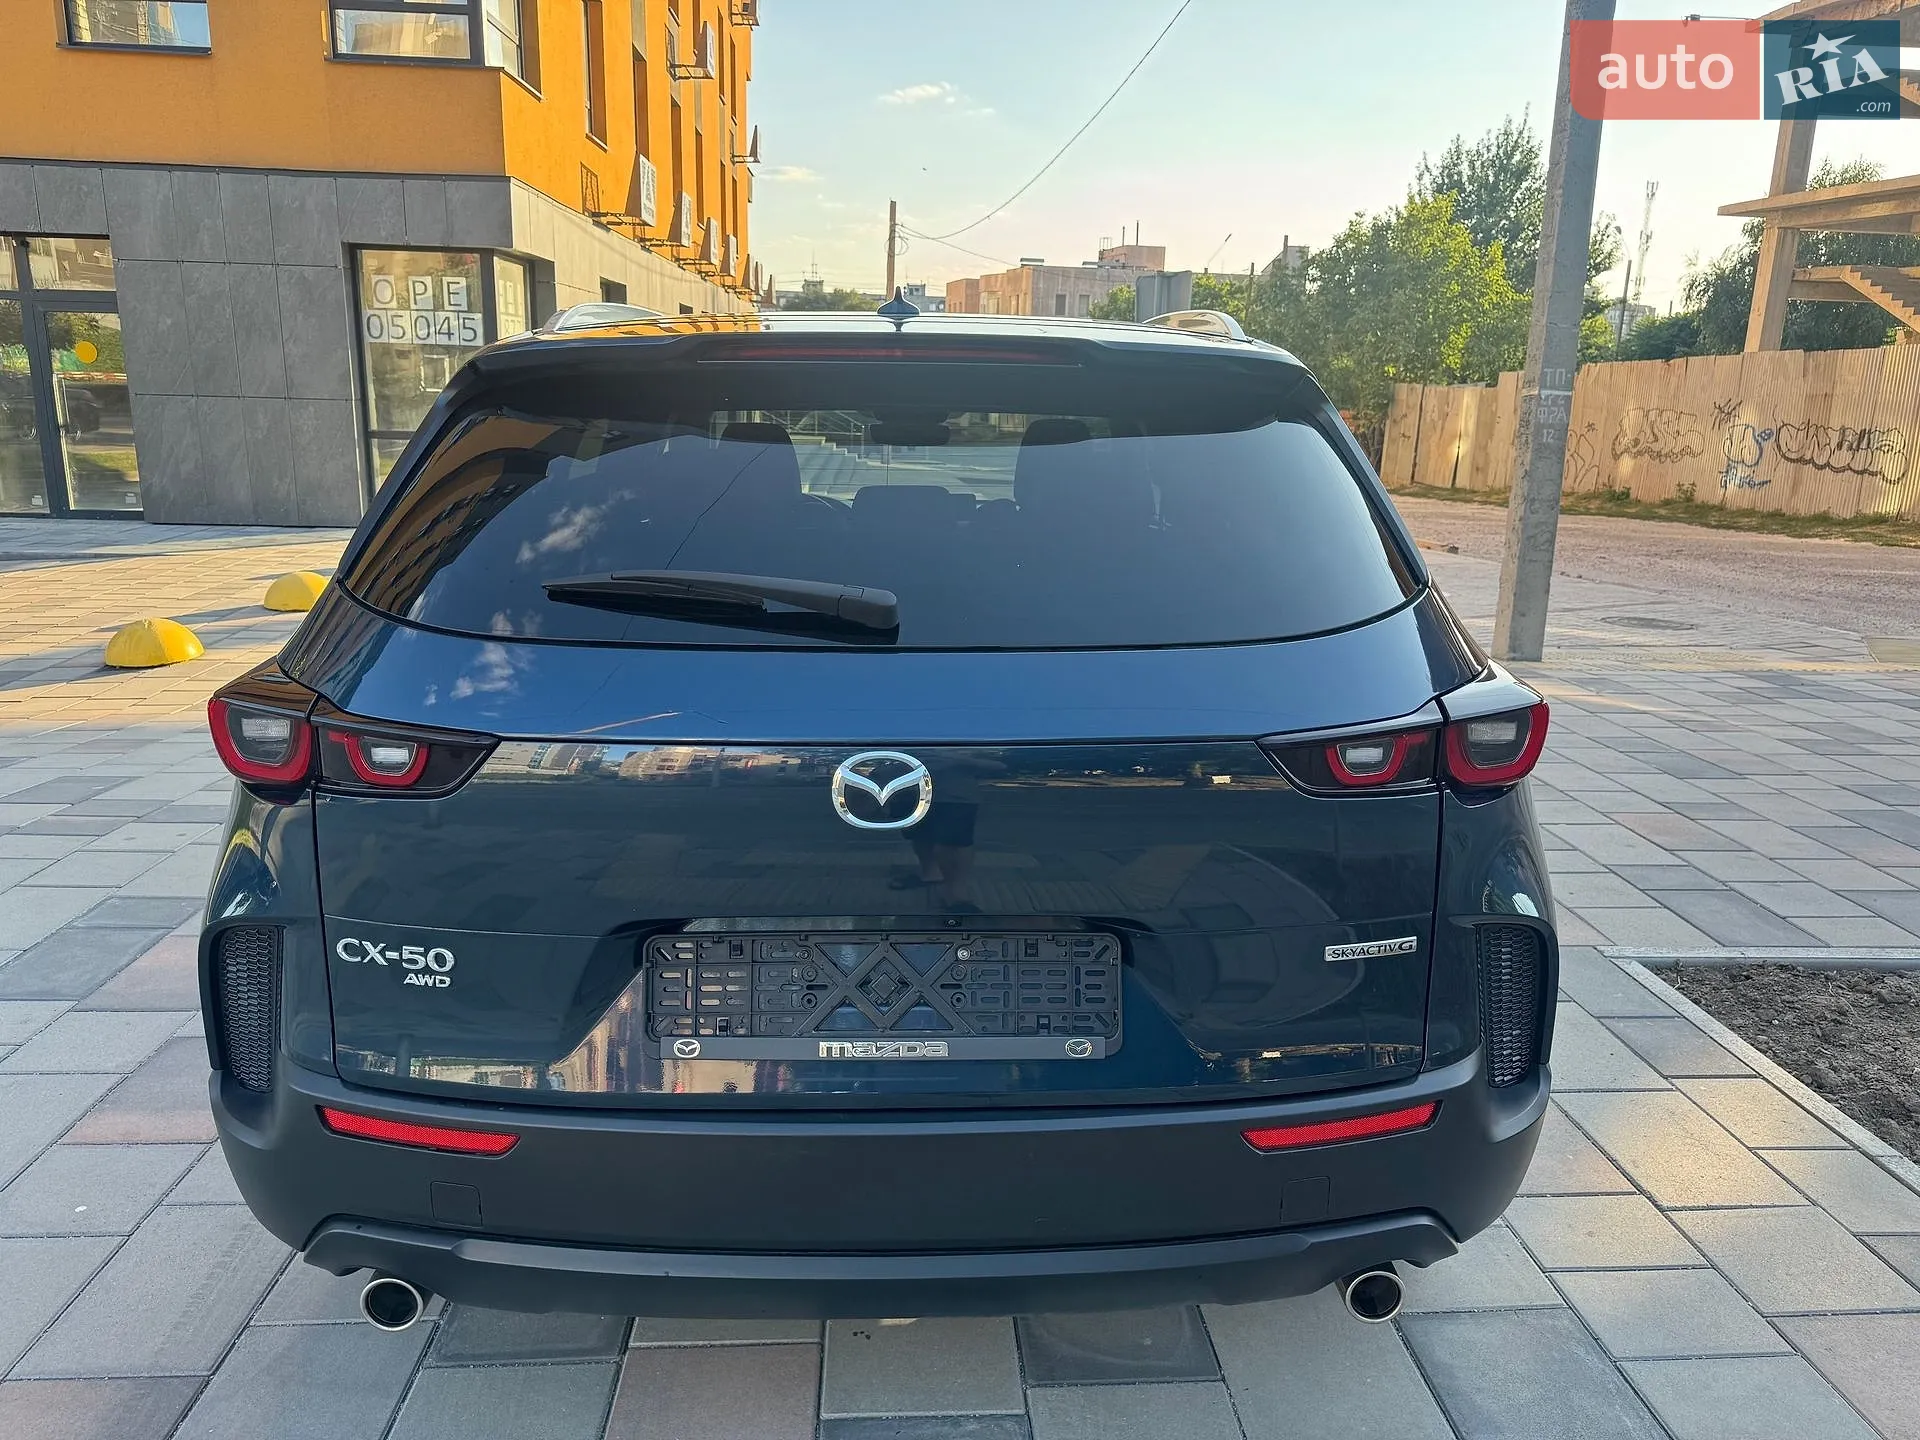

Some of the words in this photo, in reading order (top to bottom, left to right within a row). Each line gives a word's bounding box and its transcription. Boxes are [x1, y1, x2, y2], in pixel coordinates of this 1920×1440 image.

[366, 313, 478, 342] 05045
[336, 937, 455, 973] CX-50
[403, 972, 451, 988] AWD
